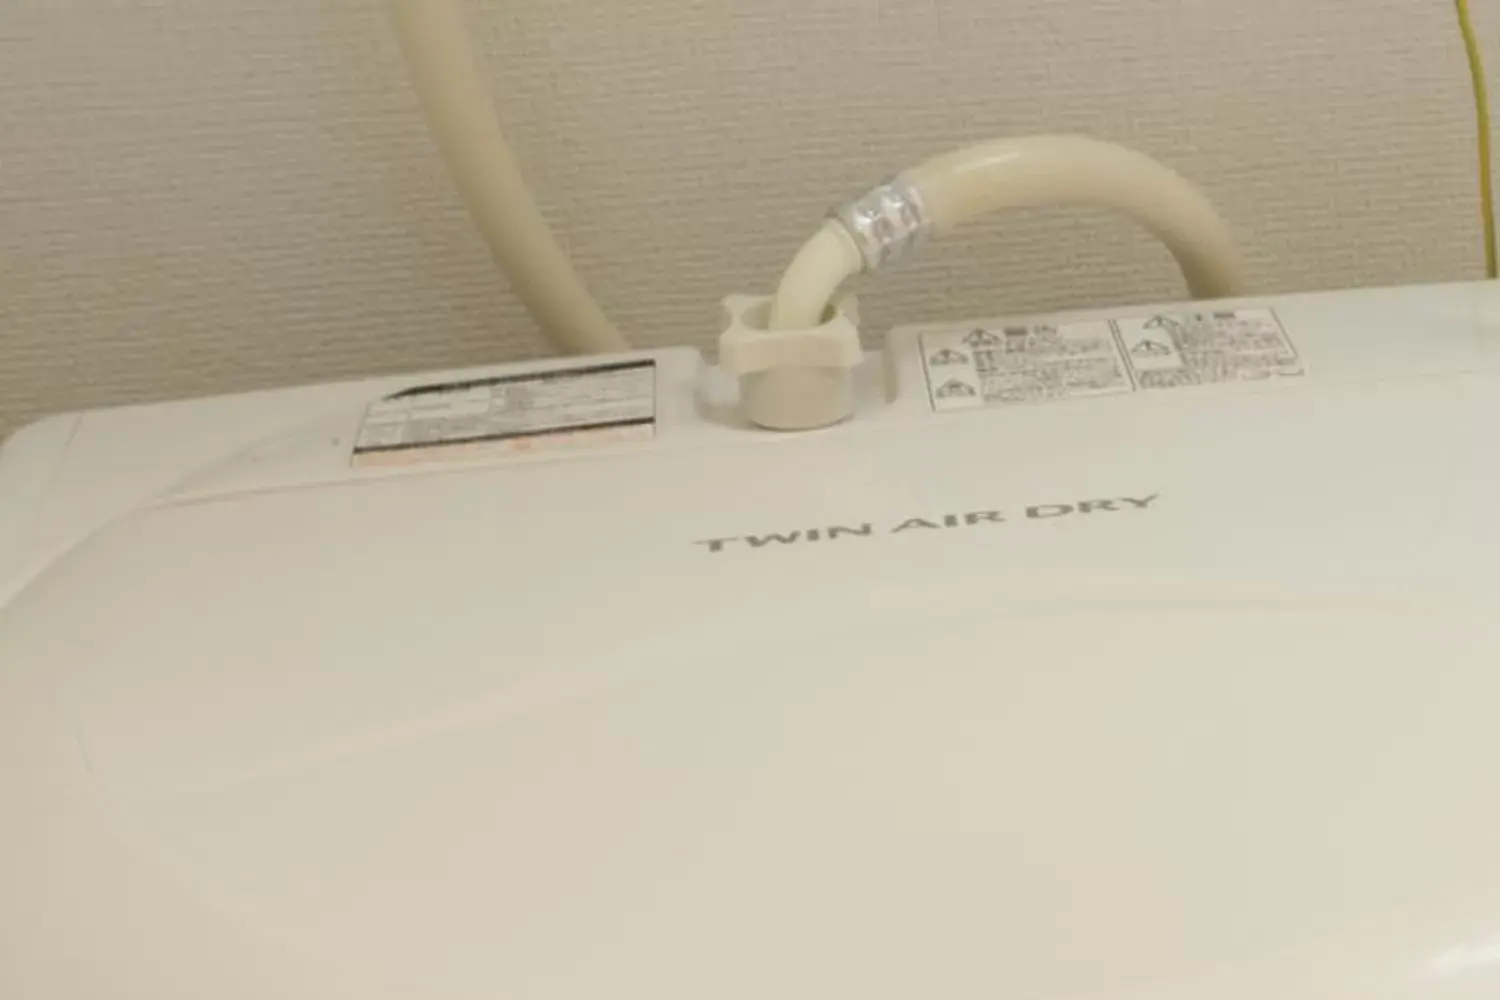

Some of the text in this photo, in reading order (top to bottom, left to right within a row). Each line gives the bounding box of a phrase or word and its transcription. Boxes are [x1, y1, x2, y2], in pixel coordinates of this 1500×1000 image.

[693, 493, 1160, 552] TWIN AIR DRY
